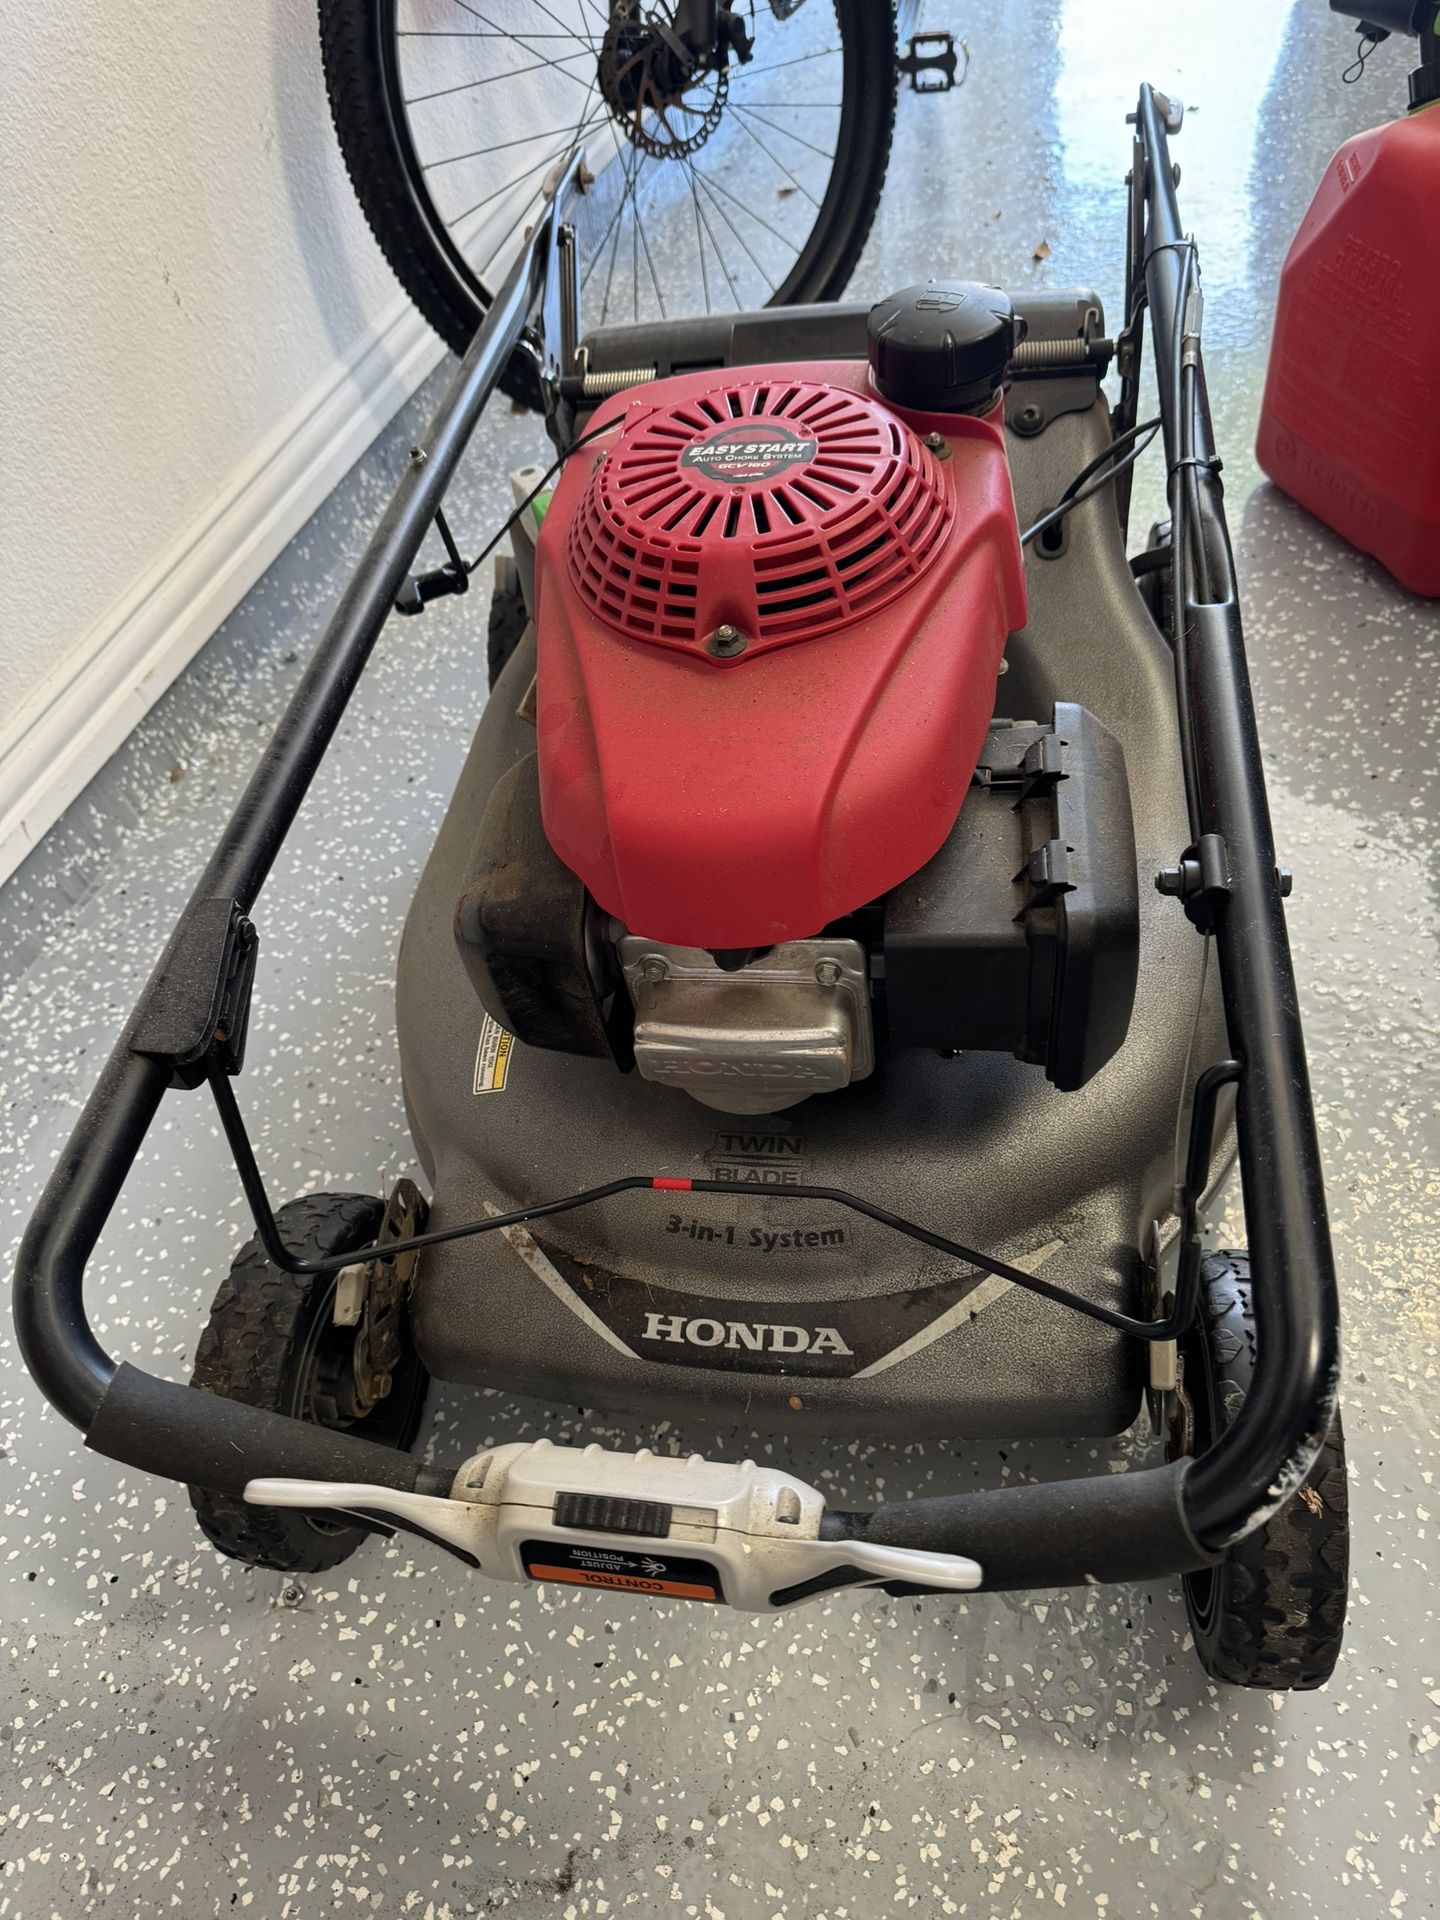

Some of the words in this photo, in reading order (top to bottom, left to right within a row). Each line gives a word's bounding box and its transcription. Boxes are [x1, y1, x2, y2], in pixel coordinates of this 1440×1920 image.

[689, 445, 743, 457] EASY
[744, 442, 810, 454] START
[651, 1060, 831, 1080] HONDA
[719, 1134, 801, 1154] TWIN
[714, 1167, 800, 1186] BLADE
[666, 1213, 735, 1245] 3-in-1
[749, 1228, 845, 1251] System
[641, 1312, 854, 1355] HONDA
[572, 1549, 624, 1562] POSITION
[580, 1560, 621, 1571] ADJUST
[578, 1573, 664, 1591] CONTROL
